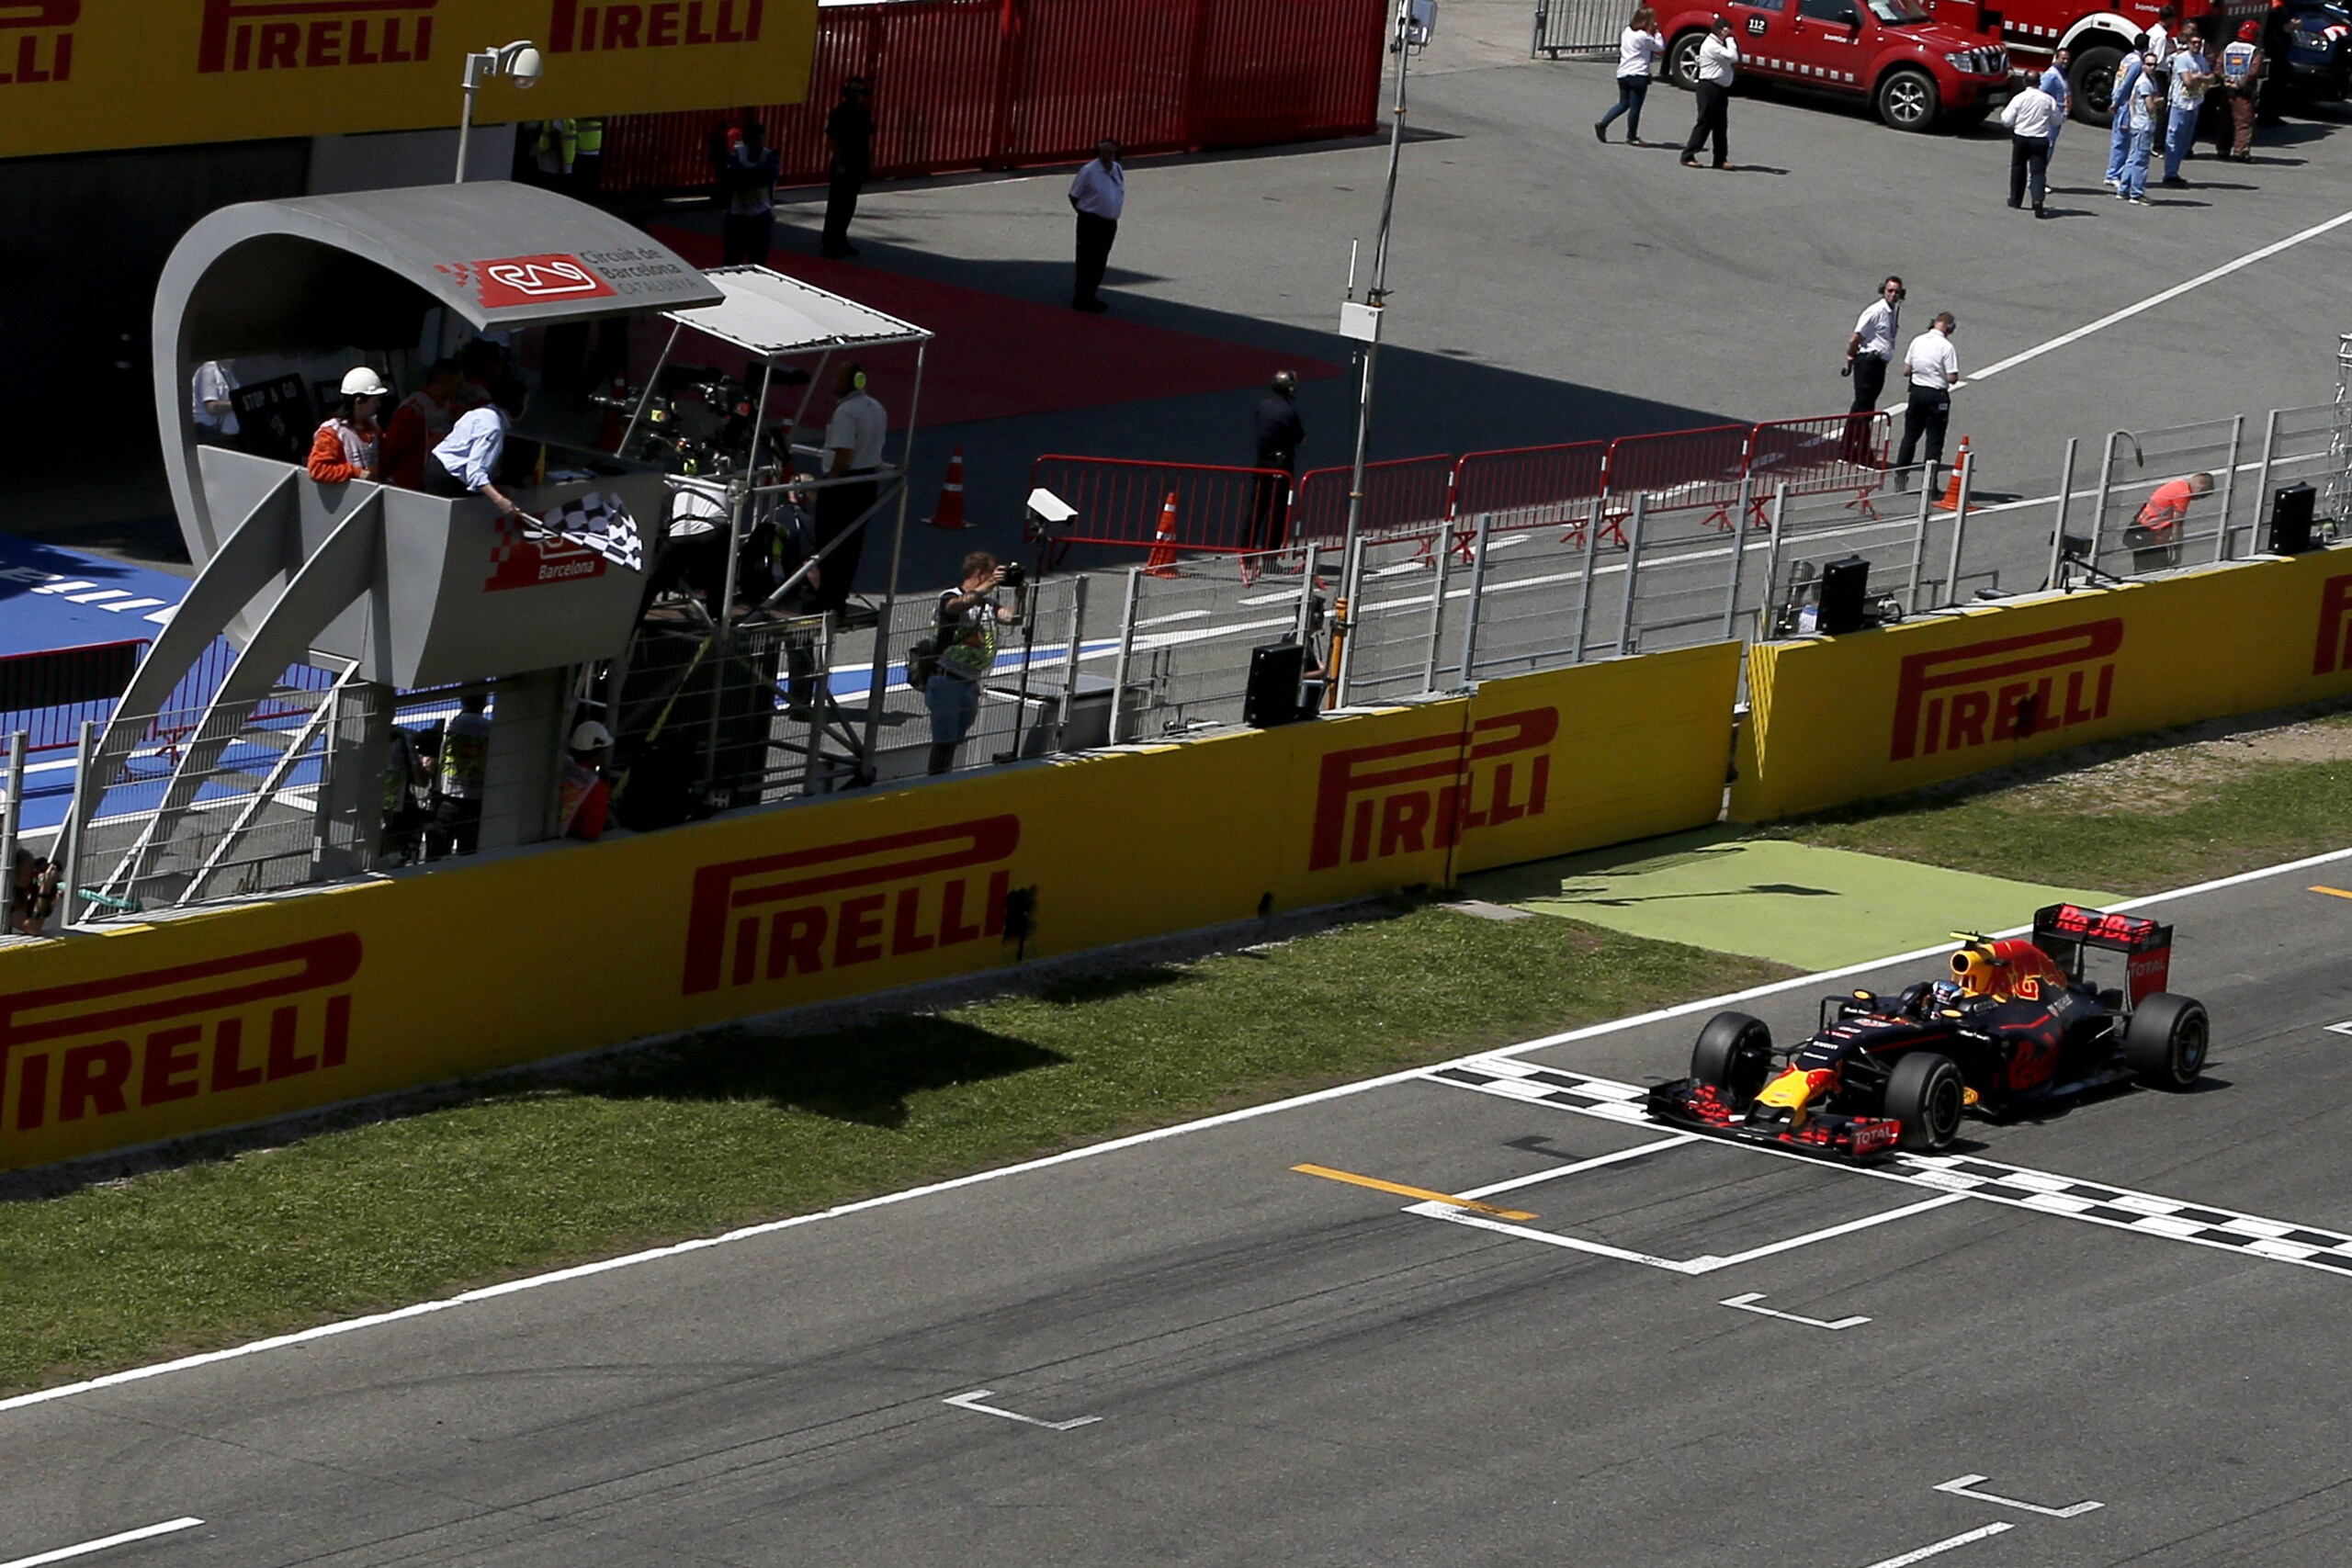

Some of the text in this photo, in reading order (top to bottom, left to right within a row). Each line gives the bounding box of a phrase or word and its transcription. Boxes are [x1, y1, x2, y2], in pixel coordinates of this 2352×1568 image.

[1748, 18, 1765, 30] 112
[198, 0, 439, 73] PIRELLI
[580, 245, 662, 265] Circuit de
[598, 262, 681, 279] Barcelona
[618, 278, 699, 295] CATALUNYA
[242, 390, 266, 412] STOP
[538, 560, 595, 580] Barcelona
[1889, 616, 2124, 762] PIRELLI
[682, 814, 1021, 997] PIRELLI
[2128, 959, 2165, 979] TOTAL
[1854, 1126, 1893, 1145] TOTAL
